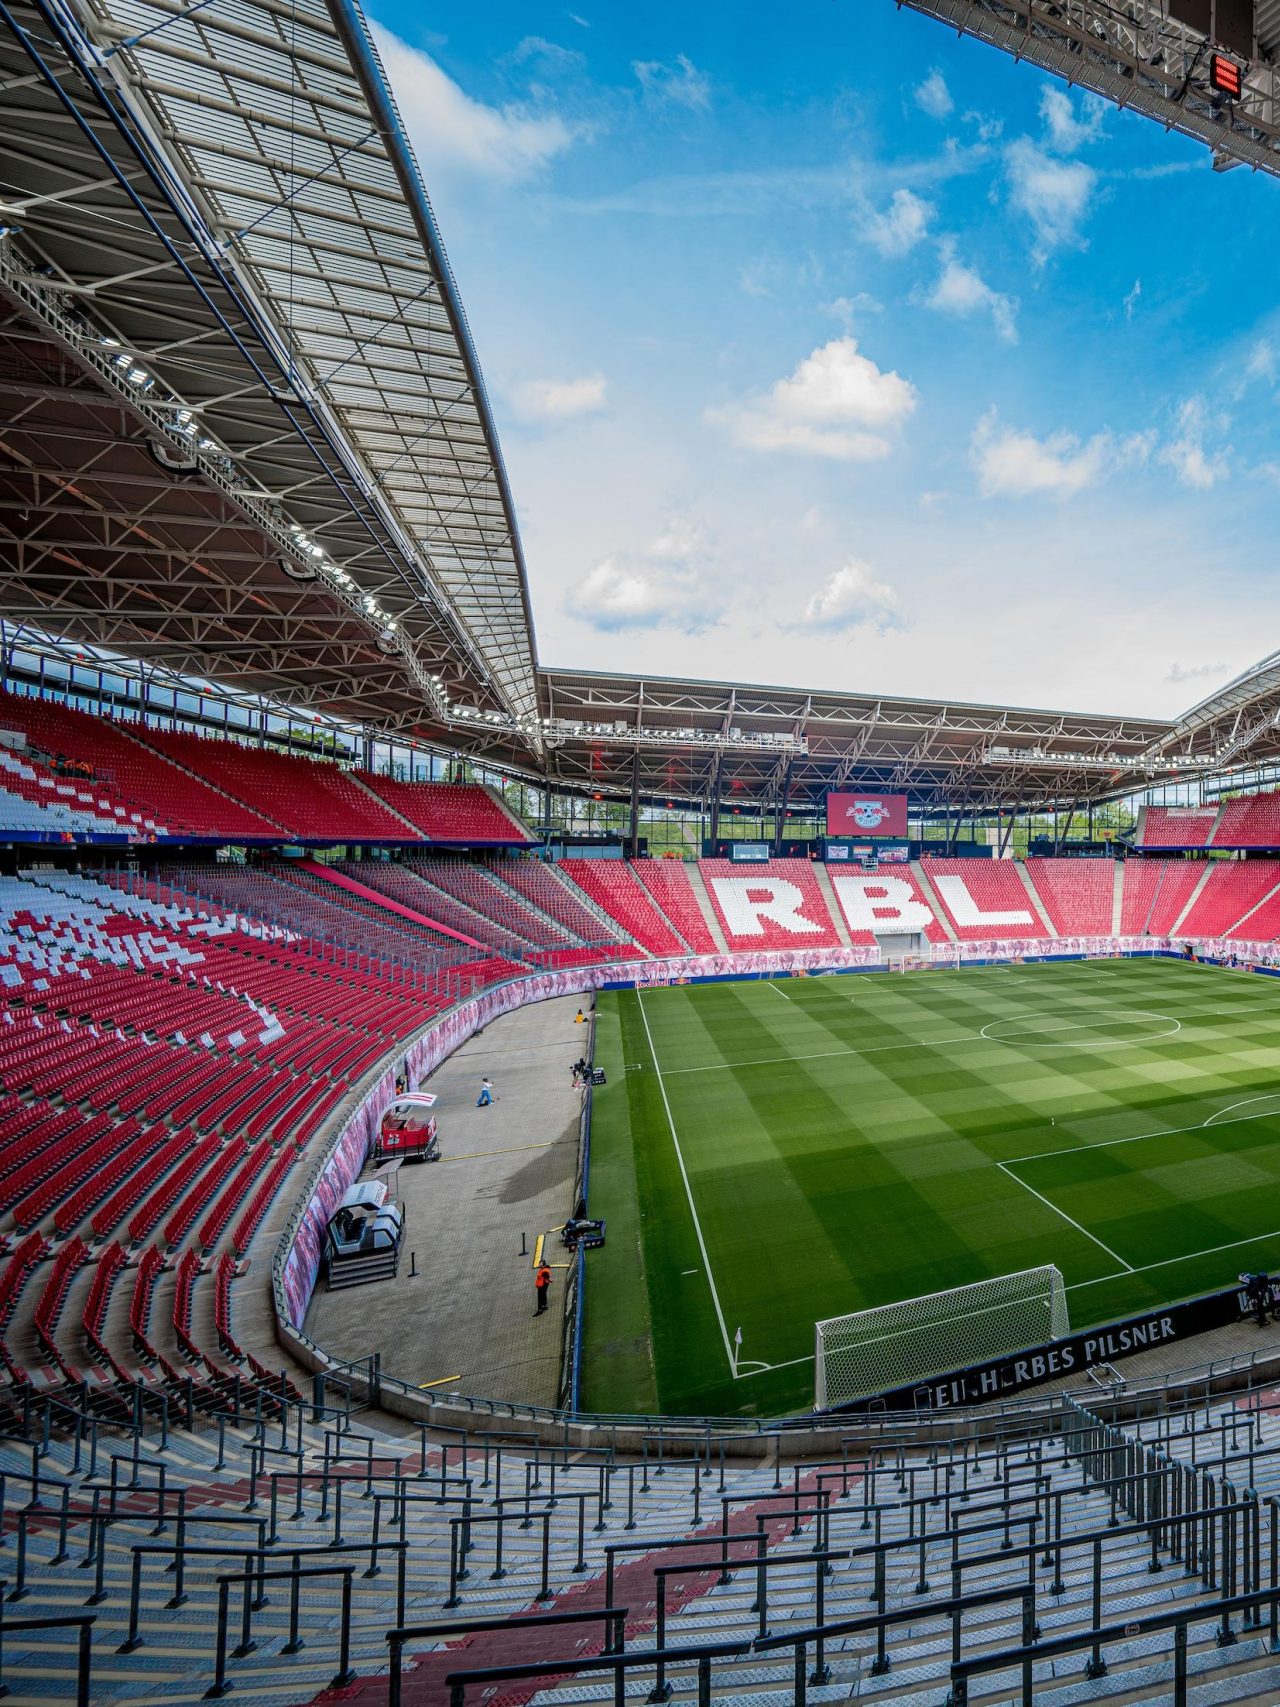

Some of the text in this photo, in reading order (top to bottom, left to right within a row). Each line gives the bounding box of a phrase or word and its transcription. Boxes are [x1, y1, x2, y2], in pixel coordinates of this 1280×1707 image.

[711, 876, 1034, 936] RBL
[636, 978, 670, 988] Red Bull
[1084, 1317, 1175, 1361] PILSNER
[673, 1584, 684, 1592] 14
[575, 1638, 589, 1648] 17
[481, 1687, 498, 1698] 19
